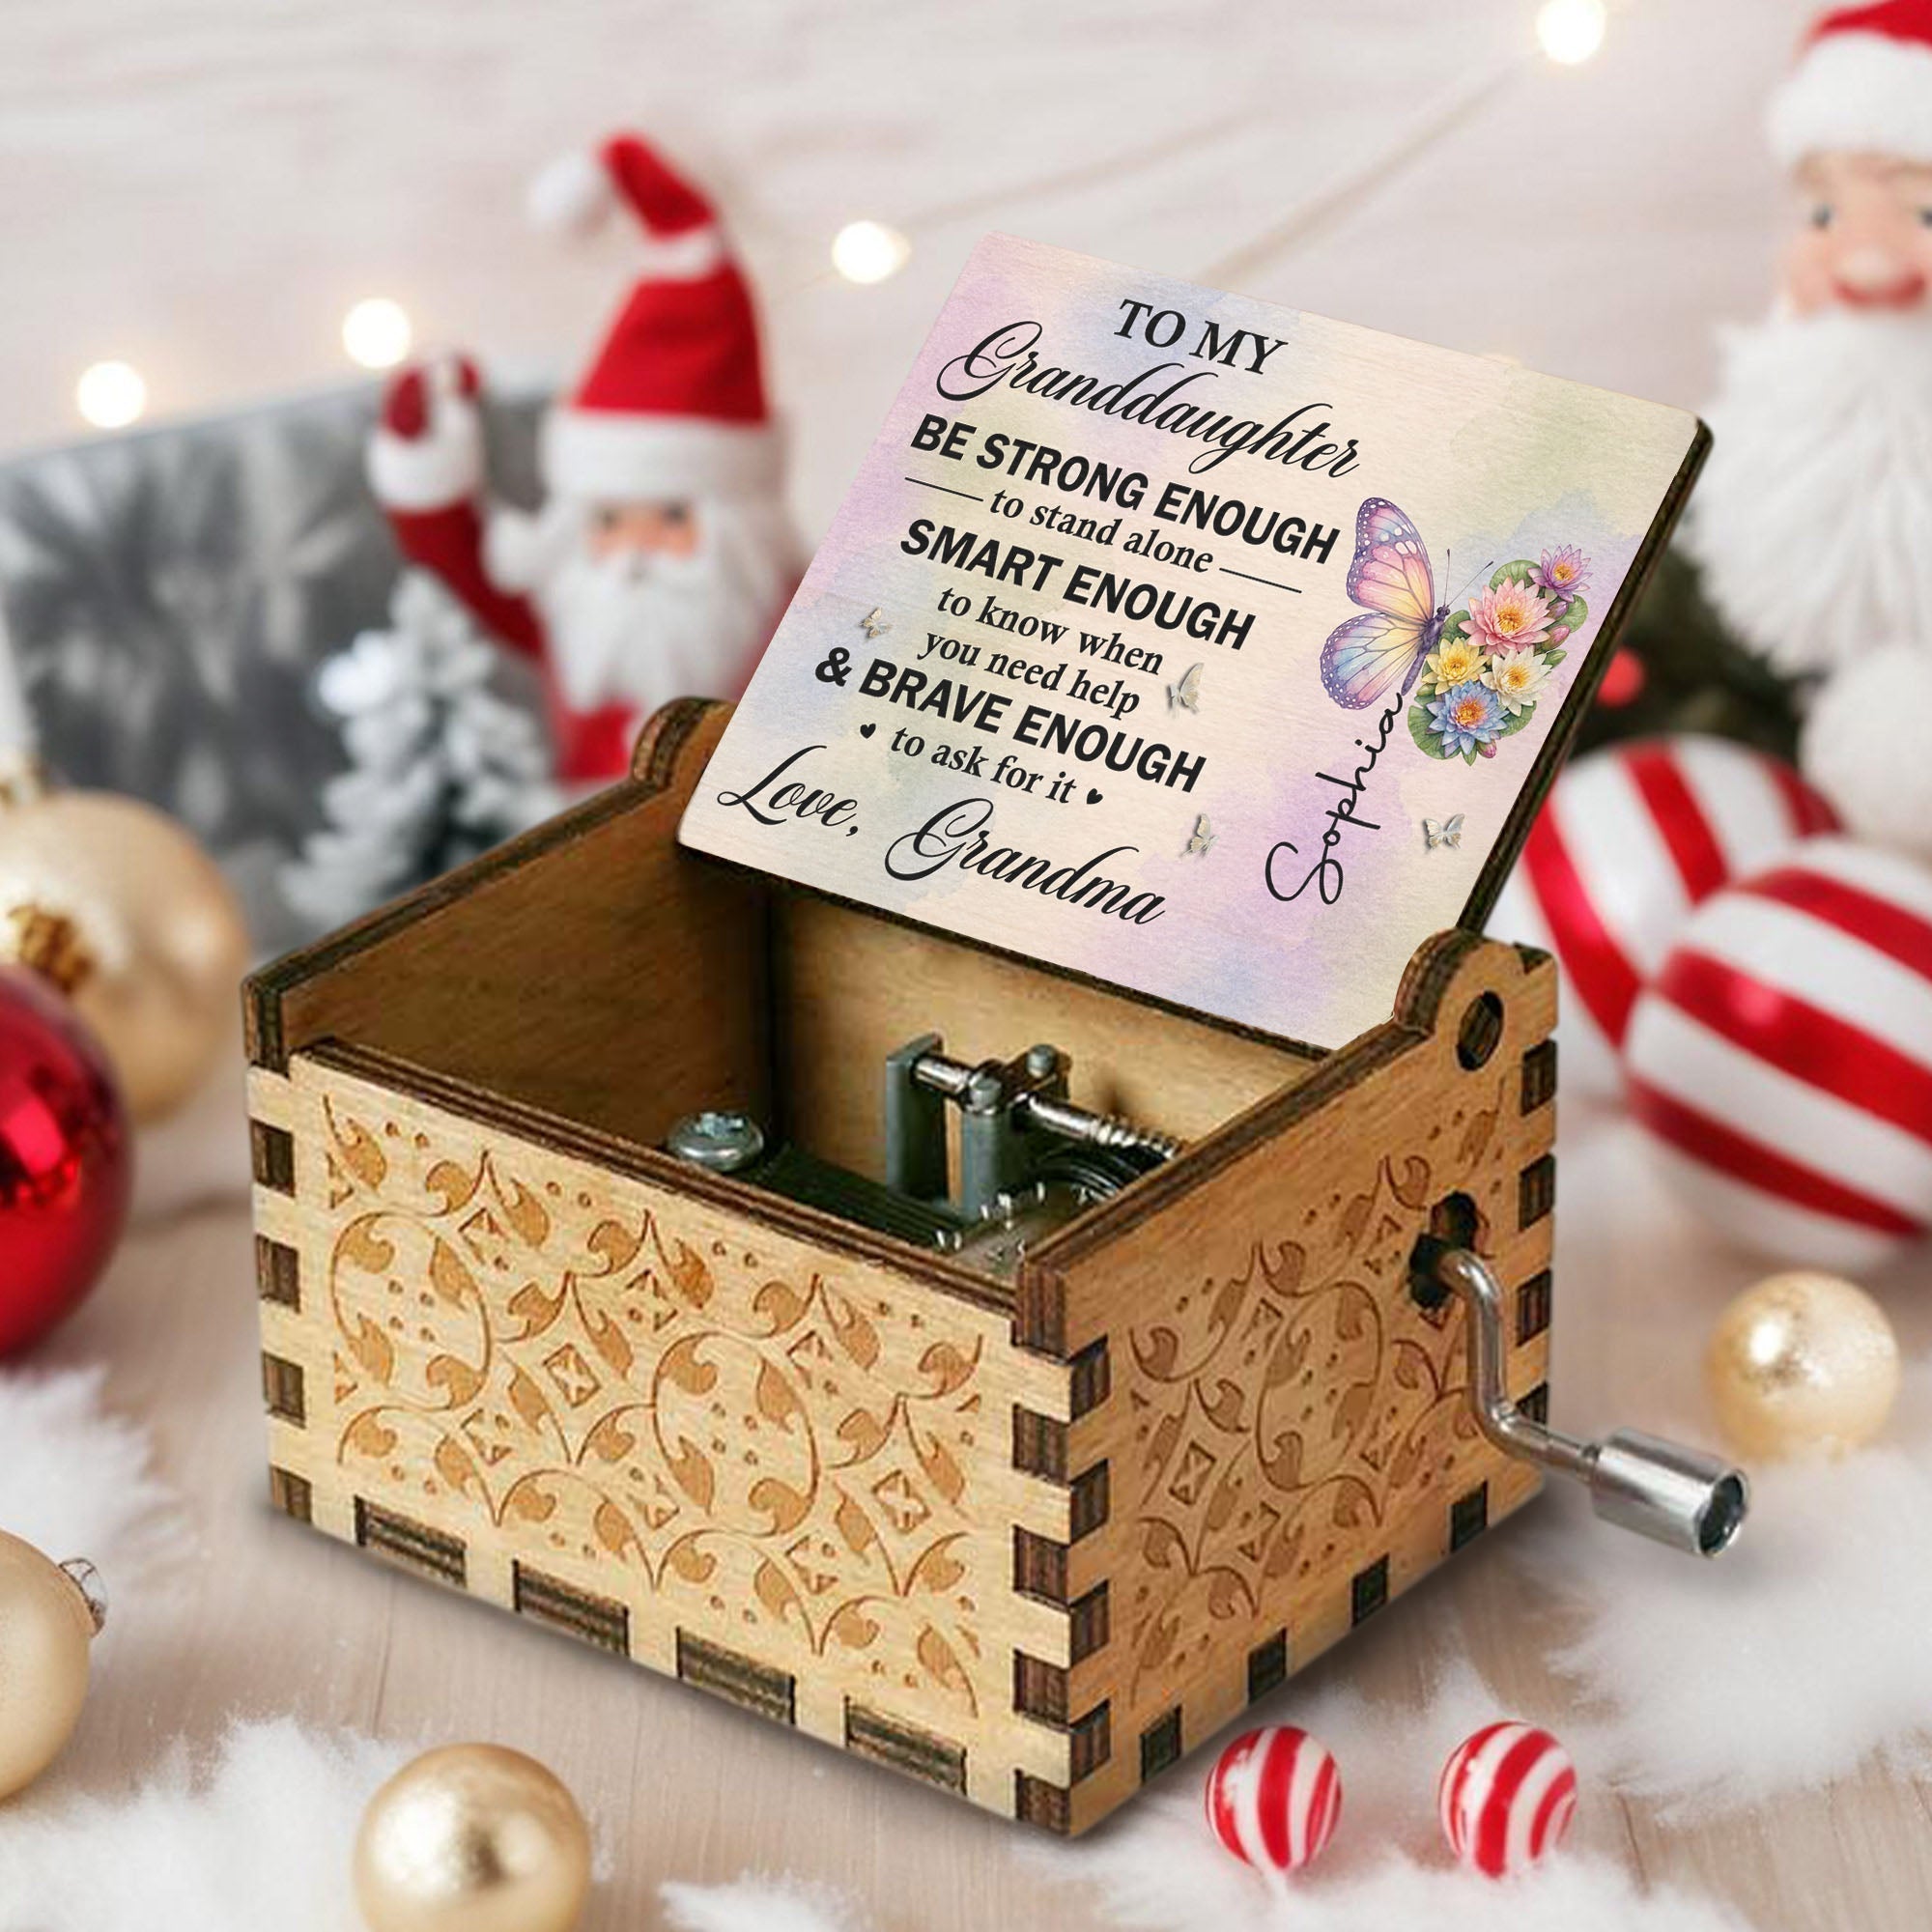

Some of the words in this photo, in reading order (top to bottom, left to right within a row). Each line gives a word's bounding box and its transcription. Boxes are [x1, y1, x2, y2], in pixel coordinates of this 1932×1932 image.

[936, 321, 1360, 478] Granddaughter
[1113, 298, 1186, 349] TO
[1188, 320, 1289, 375] MY
[910, 412, 978, 462] BE
[976, 433, 1149, 511] STRONG
[1152, 481, 1341, 565] ENOUGH
[989, 489, 1024, 519] to
[1029, 505, 1123, 546] stand
[1122, 528, 1213, 573] alone
[900, 519, 1065, 592] SMART
[1062, 564, 1257, 650] ENOUGH
[937, 587, 972, 617] to
[975, 595, 1070, 645] know
[1079, 631, 1163, 676] when
[814, 646, 853, 688] &
[858, 658, 1013, 734] BRAVE
[1012, 704, 1208, 793] ENOUGH
[917, 632, 982, 667] you
[983, 653, 1068, 692] need
[1065, 668, 1140, 721] help
[891, 726, 925, 757] to
[930, 744, 990, 778] ask
[989, 754, 1044, 794] for
[1044, 771, 1079, 805] it
[1264, 692, 1405, 906] Sophia
[717, 745, 859, 838] Love,
[884, 797, 1166, 924] Grandma
